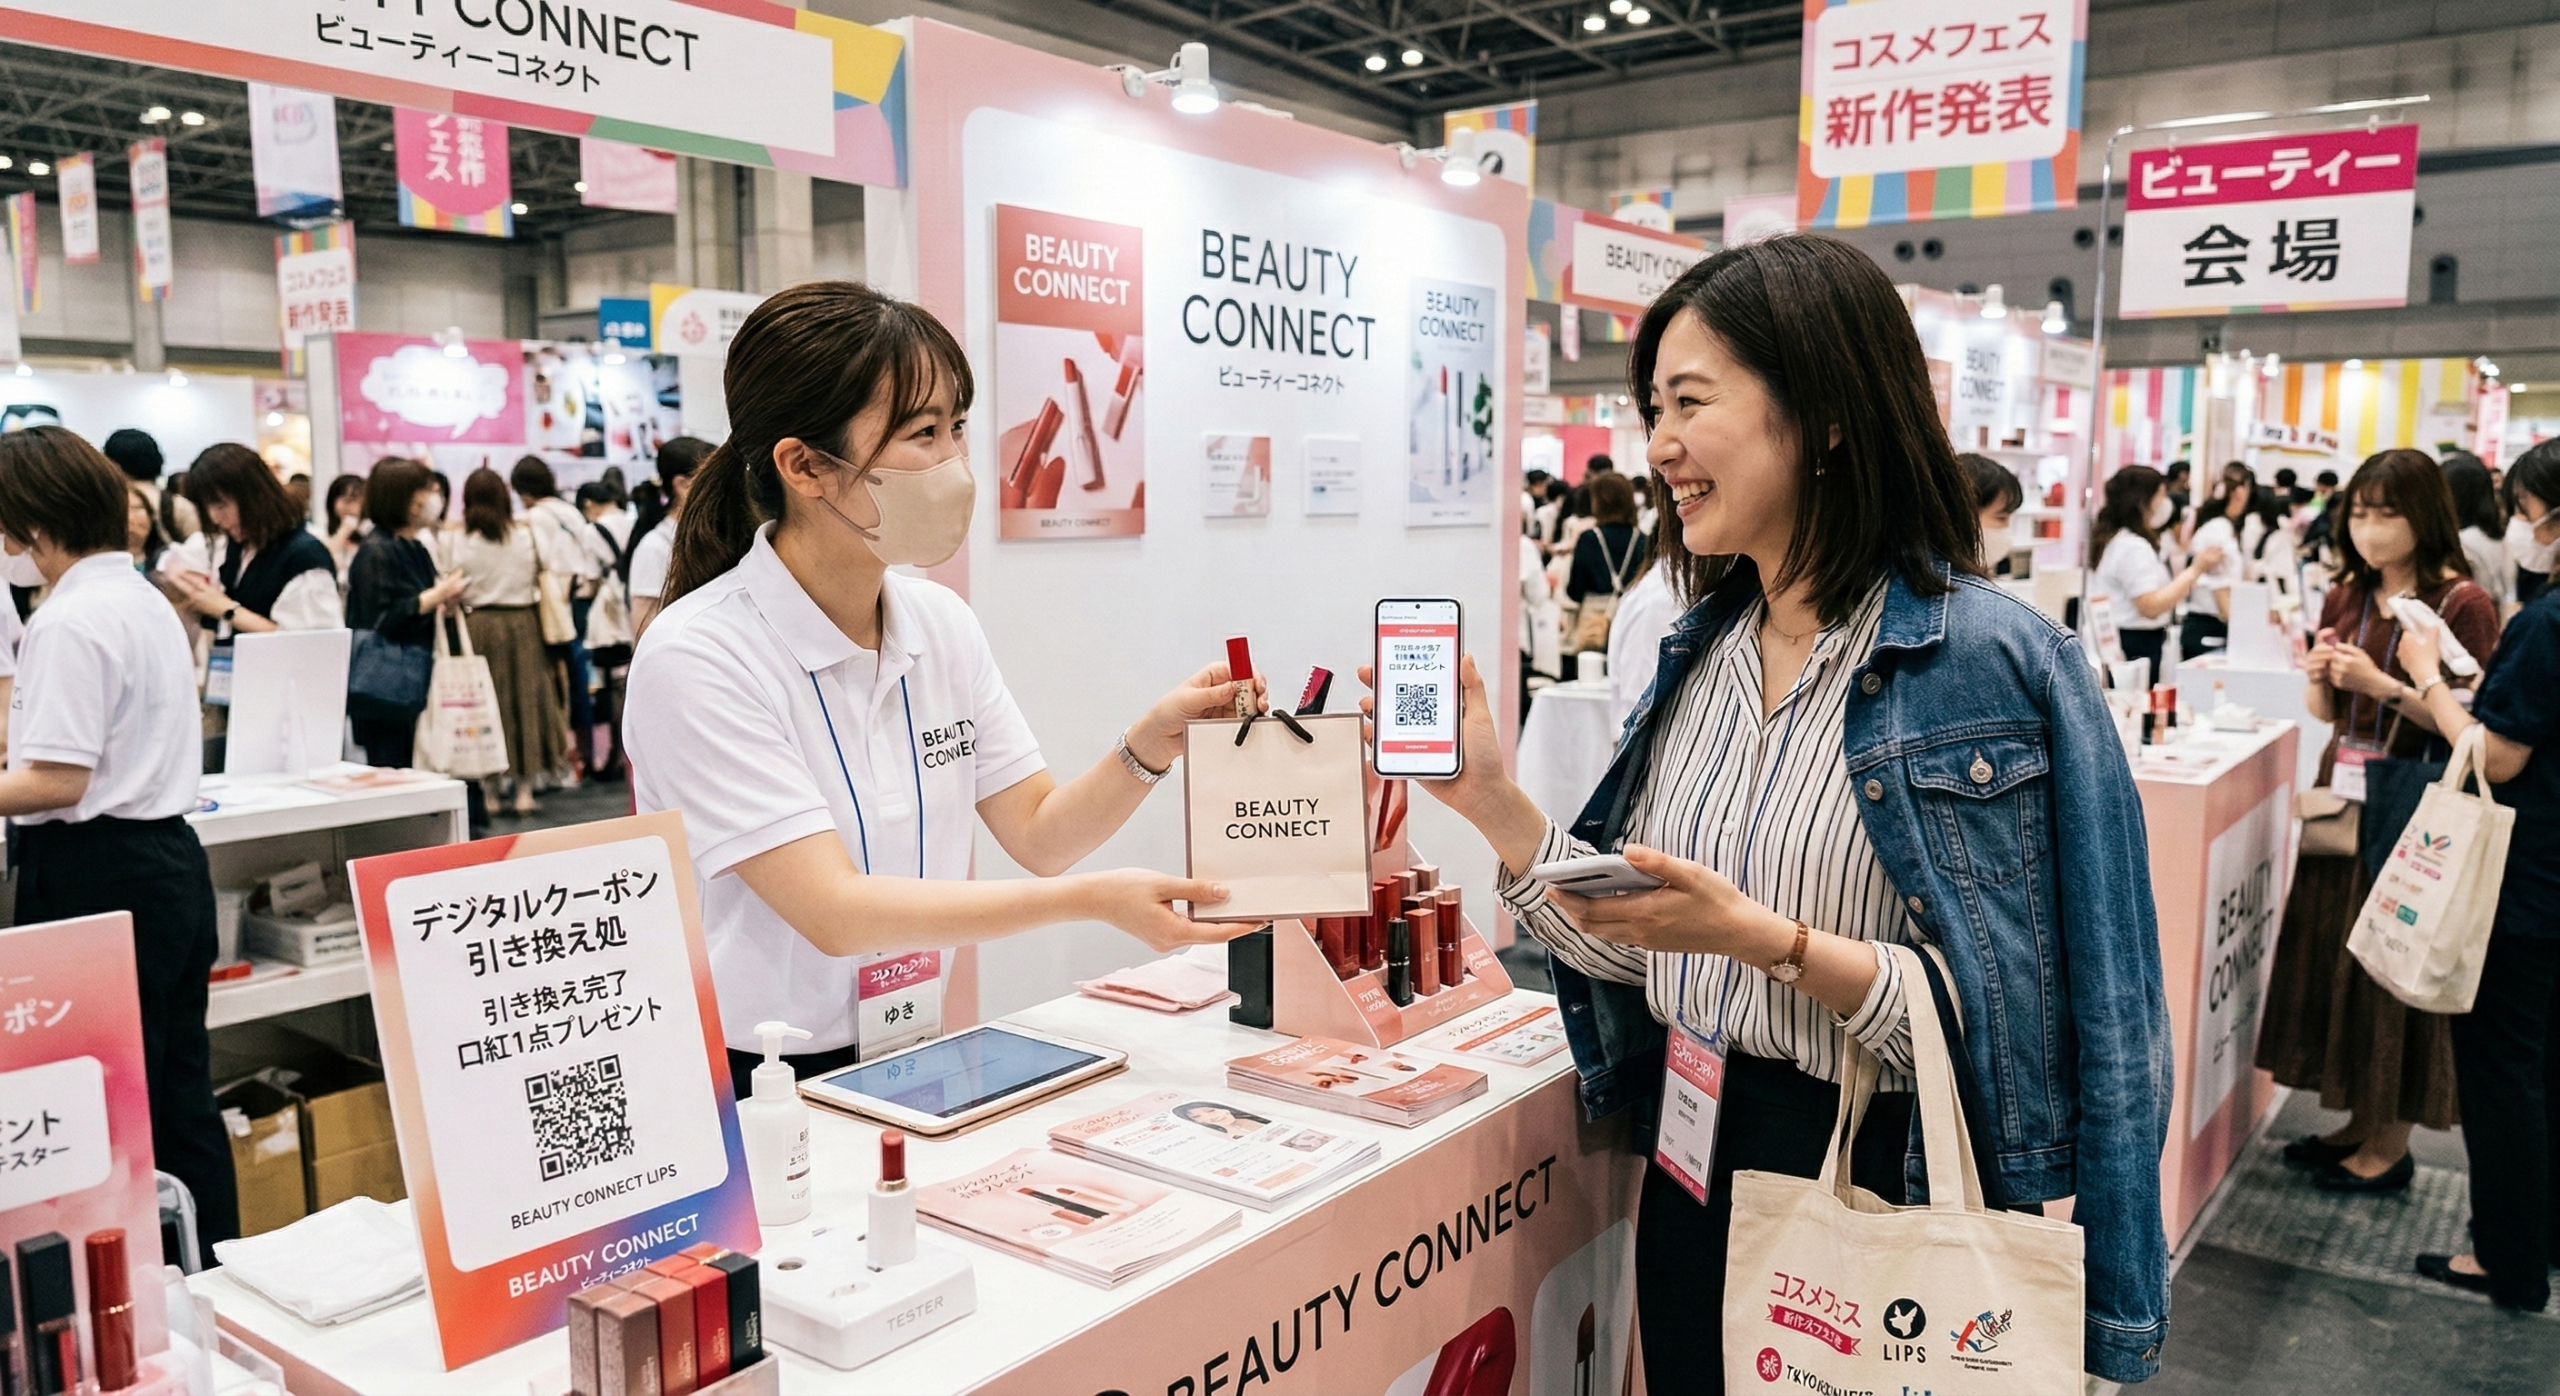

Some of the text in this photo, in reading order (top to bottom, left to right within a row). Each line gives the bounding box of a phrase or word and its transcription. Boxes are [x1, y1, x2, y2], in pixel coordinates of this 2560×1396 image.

[316, 13, 600, 93] ビューティーコネクト
[454, 0, 699, 71] CONNECT
[1832, 12, 2051, 71] コスメフェス
[1826, 74, 2053, 149] 新作発表
[2141, 147, 2401, 200] ビューティー
[1025, 233, 1120, 272] BEAUTY
[1202, 229, 1358, 298] BEAUTY
[1606, 243, 1660, 278] BEAUTY
[2183, 218, 2341, 288] 会場
[1013, 266, 1131, 306] CONNECT
[1426, 291, 1480, 319] BEAUTY
[1183, 294, 1376, 361] CONNECT
[1419, 316, 1486, 343] CONNECT
[1219, 366, 1346, 396] ビューティーコネクト
[1225, 819, 1331, 839] CONNECT
[1235, 798, 1319, 818] BEAUTY
[412, 868, 658, 942] デジタルクーポン
[466, 915, 628, 977] 引き換え処
[482, 969, 627, 1026] 引き換え完了
[884, 1001, 915, 1025] ゆき
[457, 996, 662, 1069] 口紅1点プレゼント
[510, 1163, 678, 1230] BEAUTY CONNECT LIPS
[507, 1213, 700, 1299] BEAUTY CONNECT
[1373, 1154, 1557, 1308] CONNECT
[886, 1295, 944, 1331] TESTER
[1770, 1271, 1862, 1328] コスメフェス
[1883, 1343, 1927, 1364] LIPS
